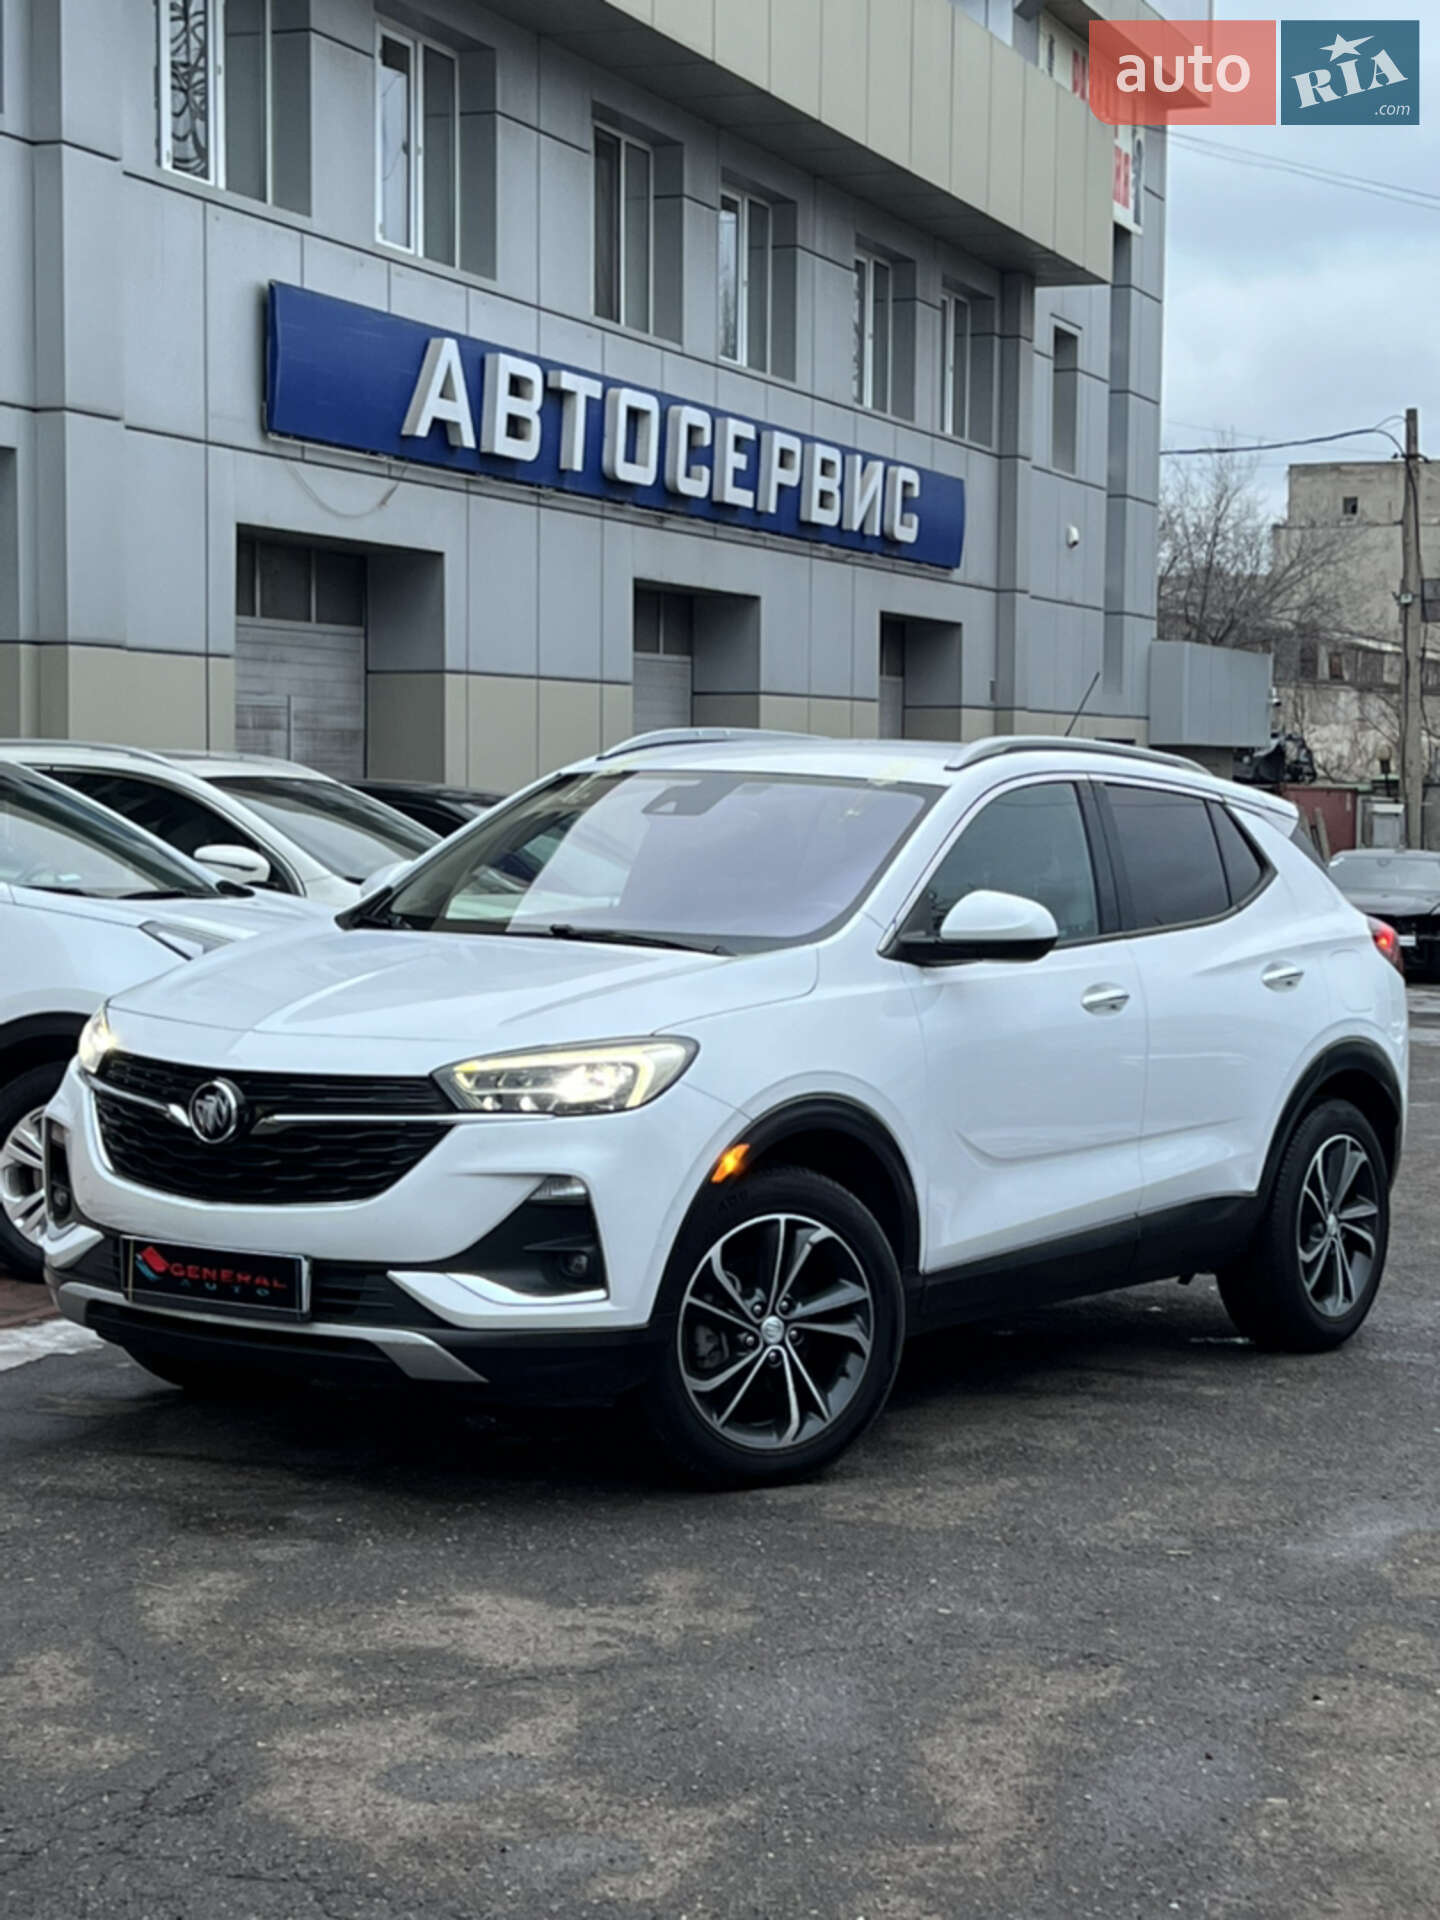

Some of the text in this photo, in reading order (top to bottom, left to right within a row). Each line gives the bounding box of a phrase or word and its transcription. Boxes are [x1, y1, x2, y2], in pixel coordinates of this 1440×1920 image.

[402, 337, 920, 544] АВТОСЕРВИС
[169, 1262, 288, 1289] GENERAL
[180, 1278, 271, 1297] AUTO
